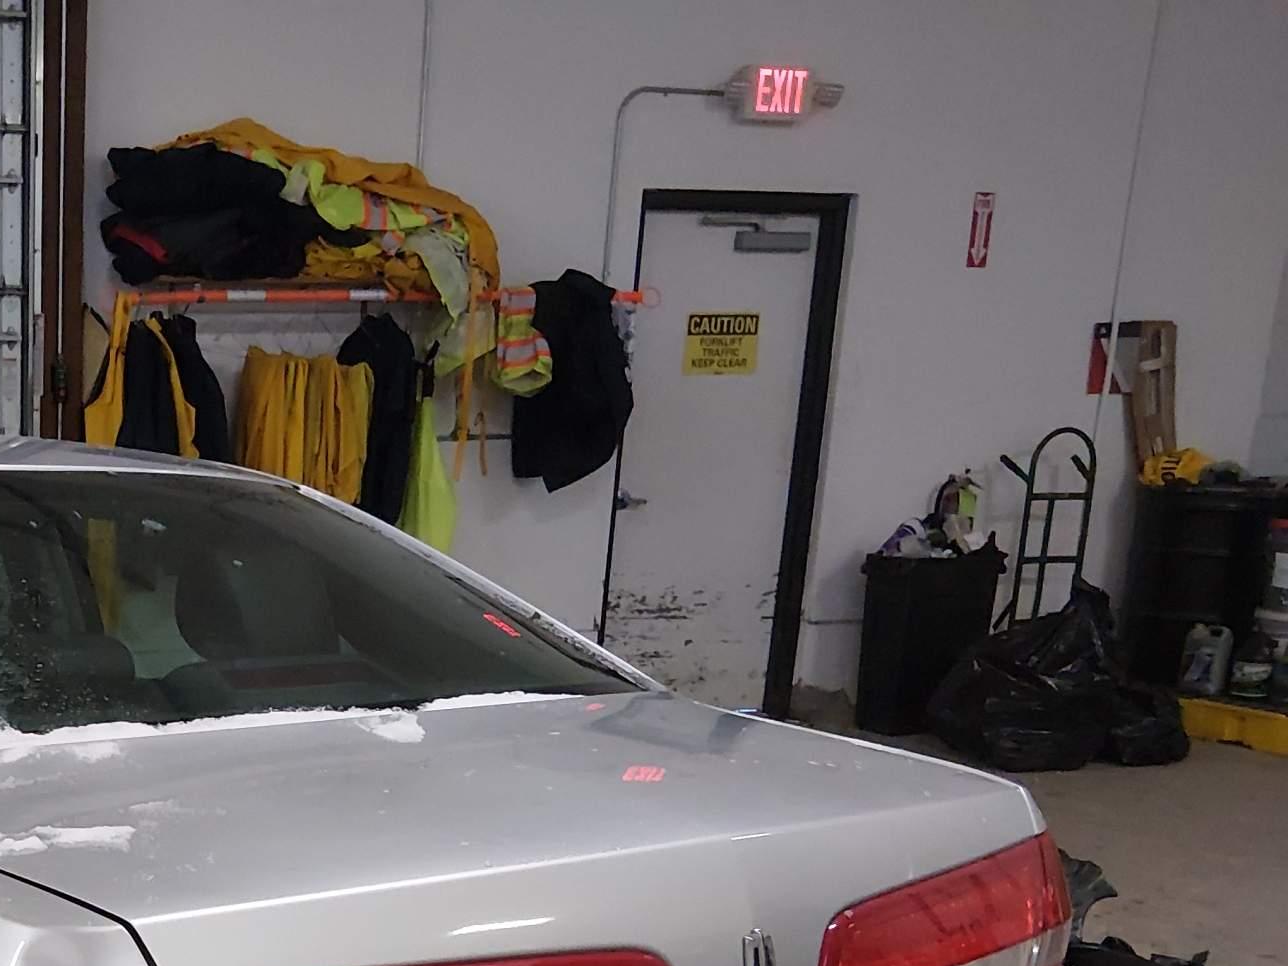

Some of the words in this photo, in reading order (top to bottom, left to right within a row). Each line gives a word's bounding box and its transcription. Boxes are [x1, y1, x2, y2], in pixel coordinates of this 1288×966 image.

[755, 68, 808, 113] EXIT
[690, 316, 758, 334] CAUTION
[702, 347, 740, 357] TRAFFIC
[691, 358, 715, 368] KEEP
[716, 358, 748, 368] CLEAR
